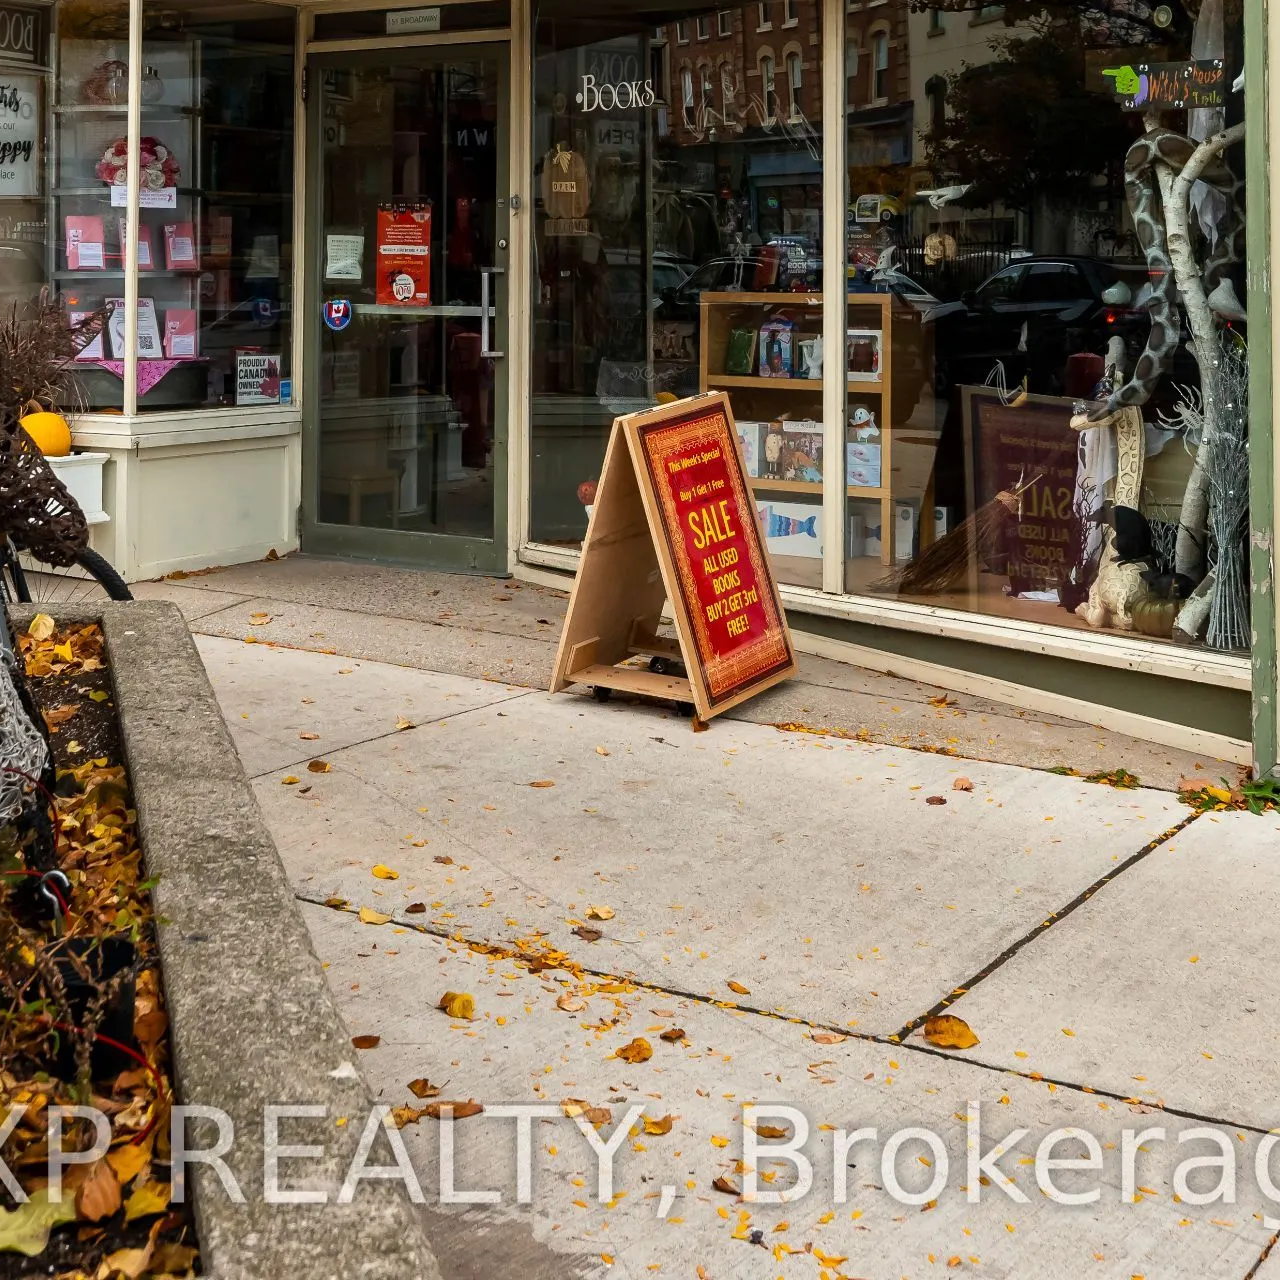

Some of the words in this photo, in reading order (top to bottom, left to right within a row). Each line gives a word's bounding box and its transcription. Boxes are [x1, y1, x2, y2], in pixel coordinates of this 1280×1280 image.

[400, 14, 438, 25] BROADWAY
[238, 358, 267, 368] PROUDLY
[238, 381, 261, 390] OWNED
[668, 459, 681, 473] This
[681, 452, 701, 470] Week's
[701, 448, 720, 464] Special
[679, 487, 692, 502] Buy
[697, 483, 707, 496] Get
[712, 478, 724, 491] Free
[688, 500, 736, 550] SALE
[703, 554, 719, 575] ALL
[719, 548, 738, 569] USED
[713, 573, 741, 595] BOOKS
[706, 601, 722, 623] BUY
[722, 598, 730, 616] 2
[729, 592, 744, 613] GET
[743, 585, 758, 606] 3rd
[726, 616, 749, 637] FREE!
